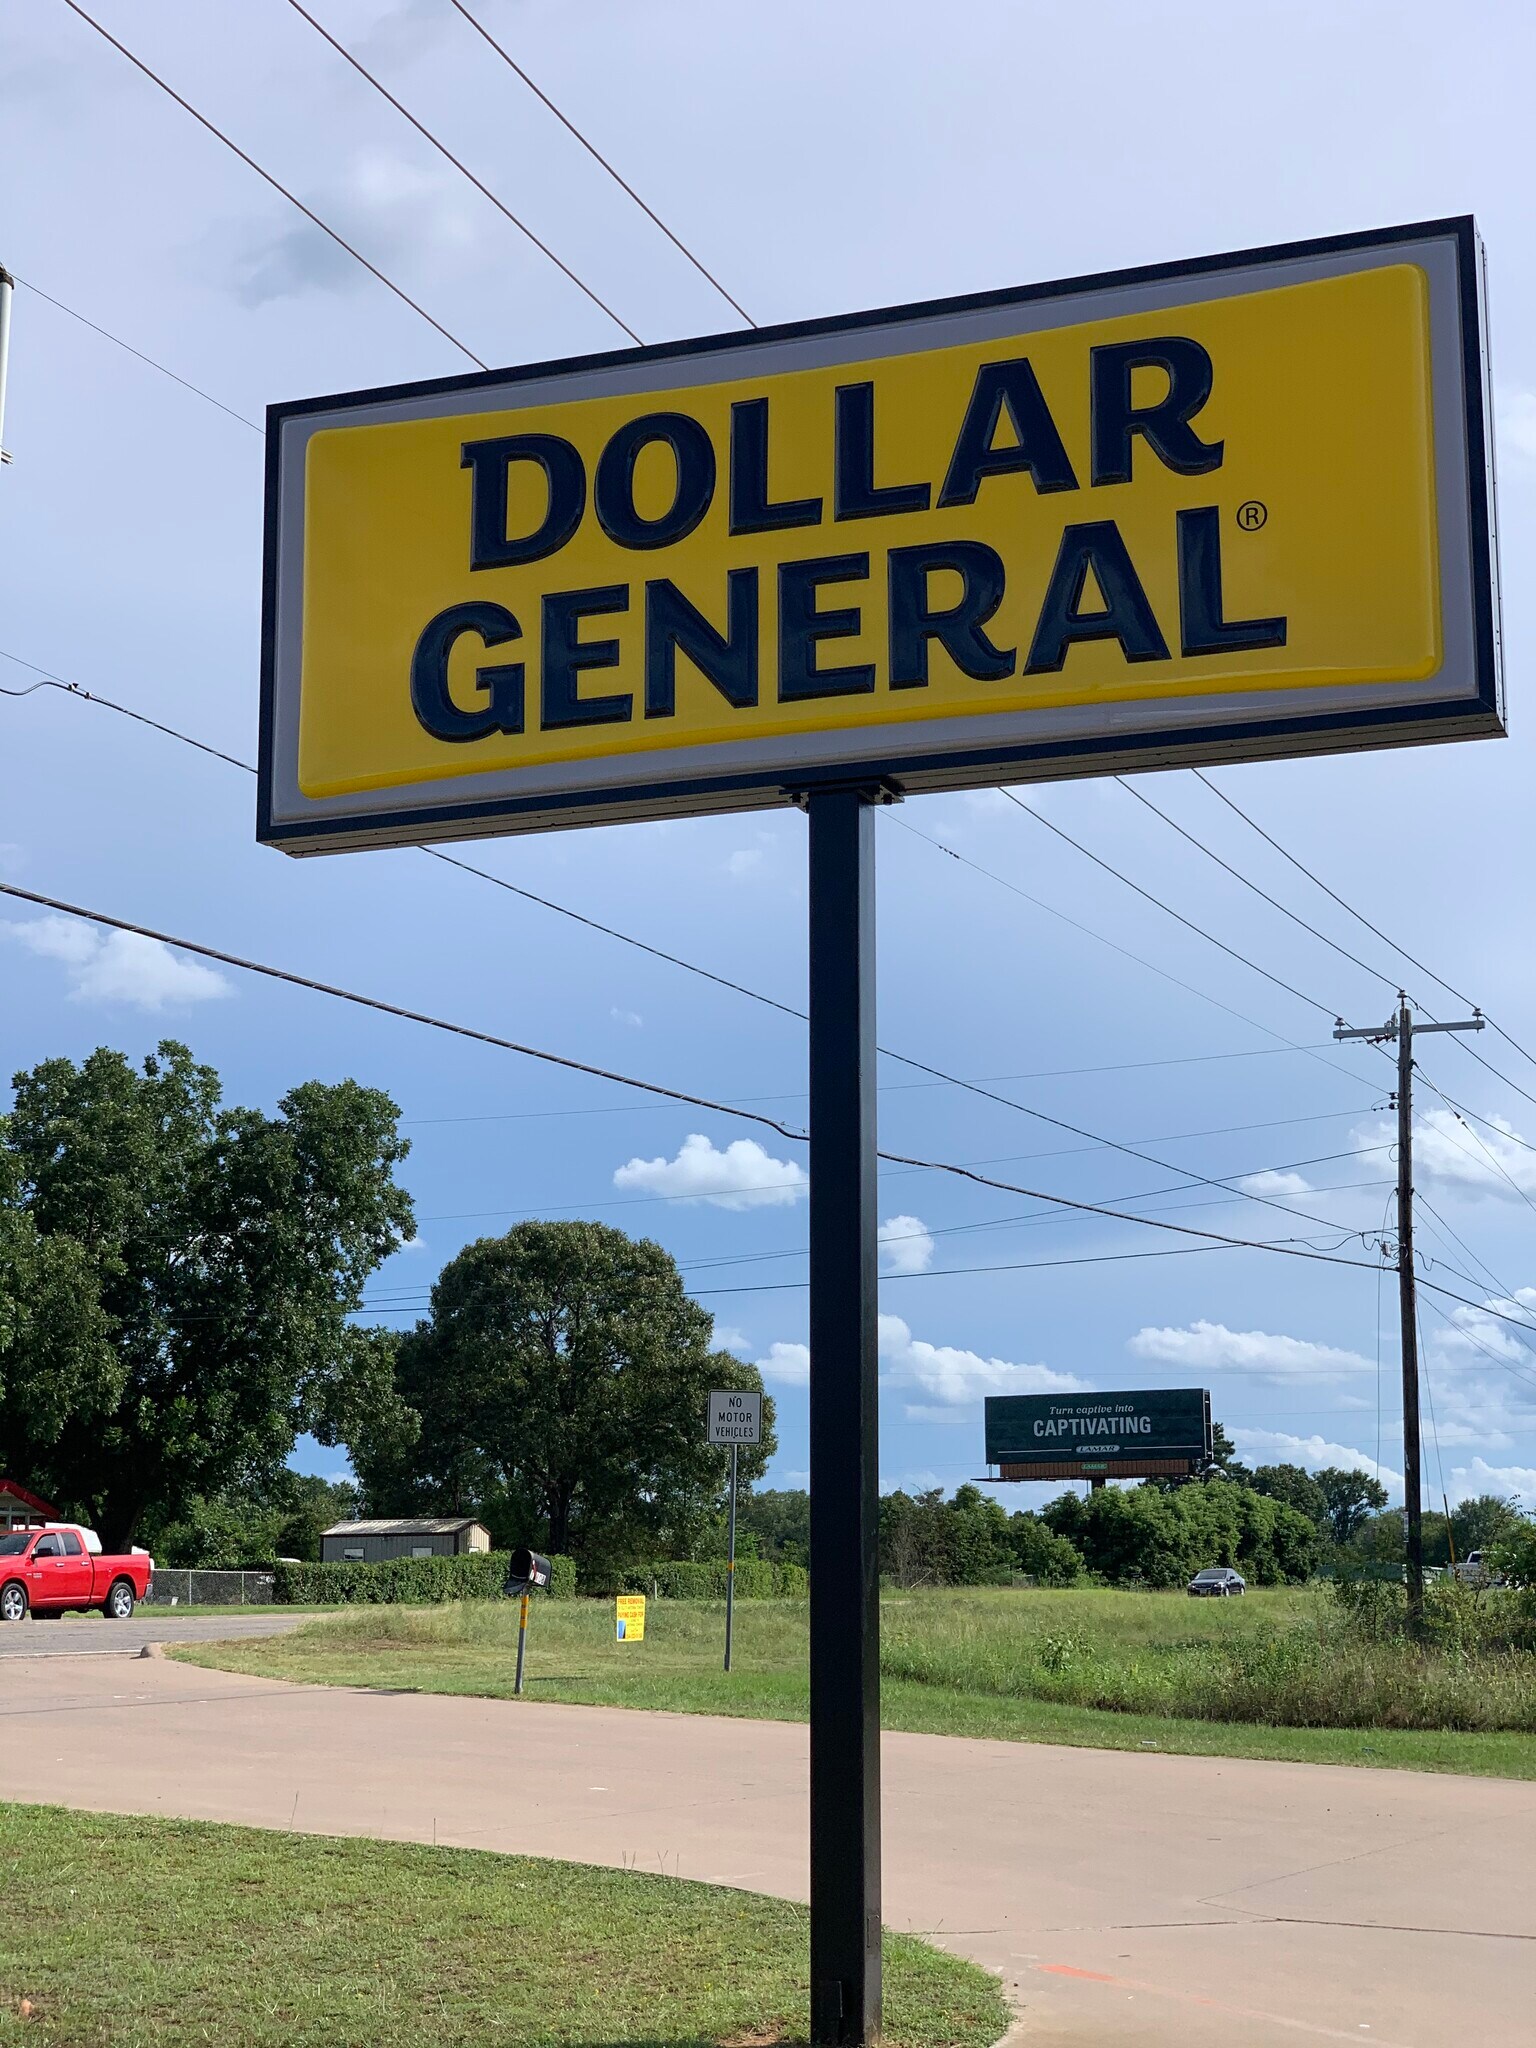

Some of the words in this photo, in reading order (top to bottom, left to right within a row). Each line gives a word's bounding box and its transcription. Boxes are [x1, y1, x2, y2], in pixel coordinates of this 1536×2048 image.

[460, 336, 1225, 572] DOLLAR
[410, 505, 1288, 743] GENERAL
[728, 1397, 743, 1408] NO
[1050, 1406, 1074, 1415] Turn
[1075, 1405, 1112, 1416] captive
[1115, 1404, 1135, 1413] into
[718, 1412, 753, 1423] MOTOR
[715, 1426, 754, 1438] VEHICLES
[1033, 1416, 1152, 1437] CAPTIVATING
